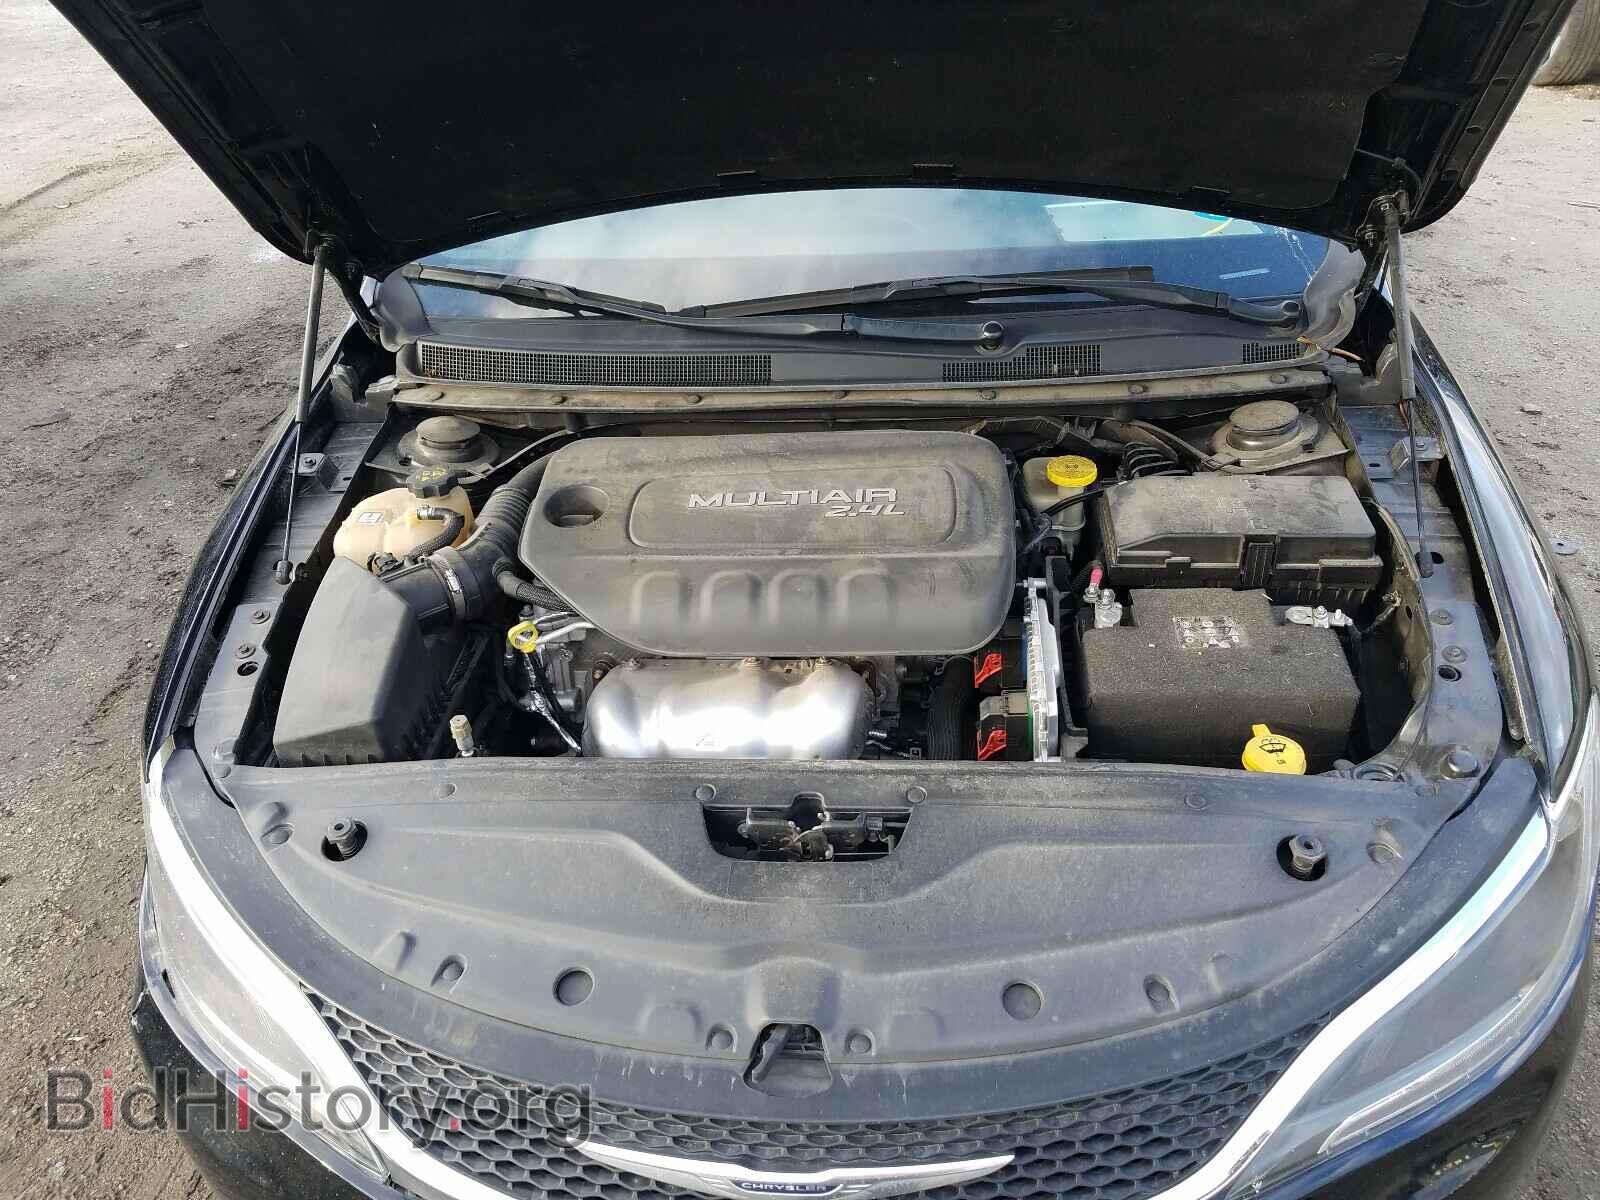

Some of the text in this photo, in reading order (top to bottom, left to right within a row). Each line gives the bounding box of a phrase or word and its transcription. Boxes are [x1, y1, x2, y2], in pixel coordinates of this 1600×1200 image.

[688, 488, 898, 508] MULTIAIR
[824, 503, 905, 518] 2.4L
[741, 1182, 827, 1191] CHRYSLER
